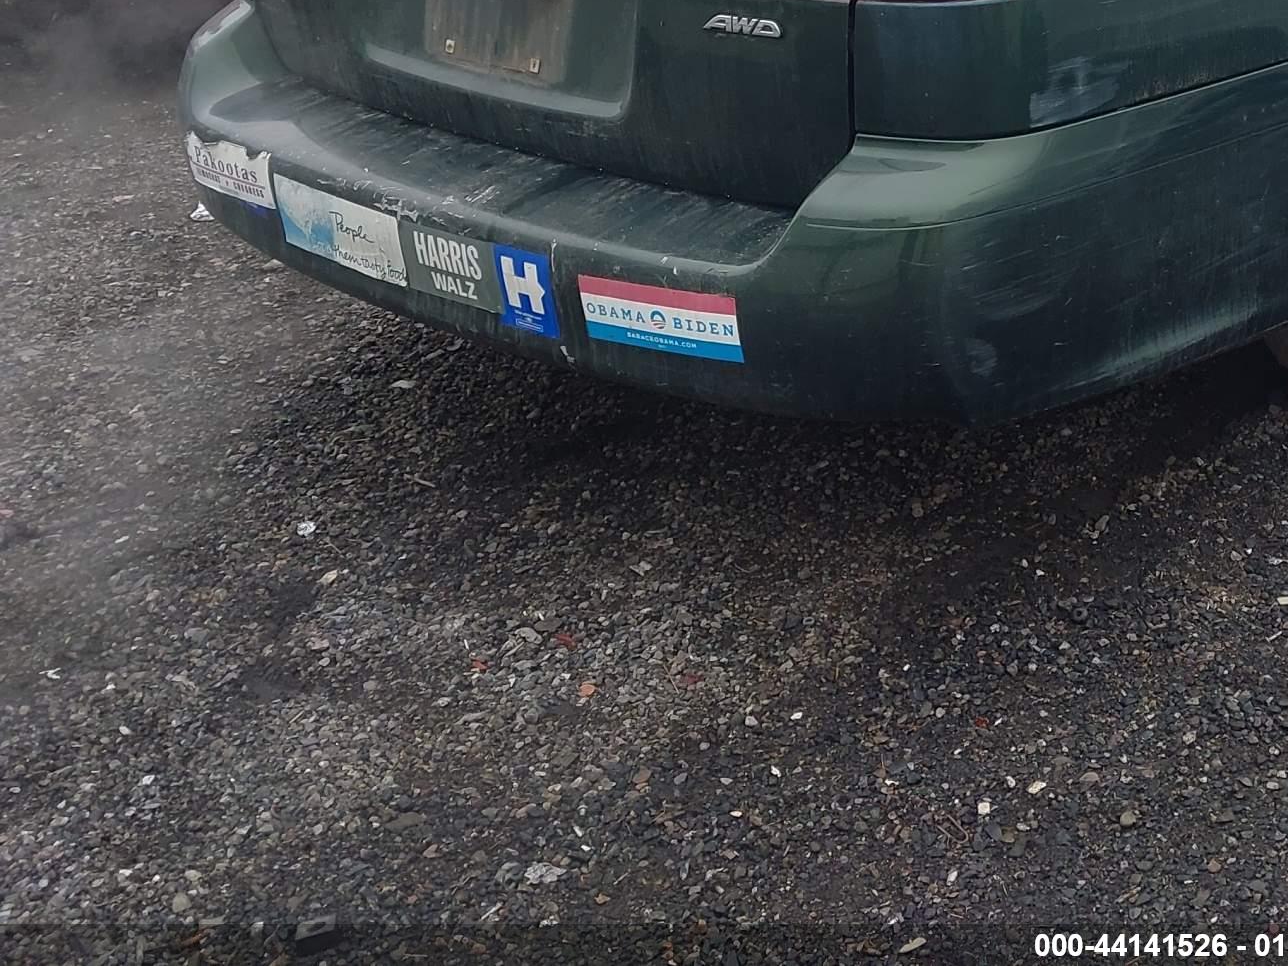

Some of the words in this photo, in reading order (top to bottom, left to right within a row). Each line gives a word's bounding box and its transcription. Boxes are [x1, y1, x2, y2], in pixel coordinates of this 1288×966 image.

[703, 14, 781, 38] AWD
[194, 145, 258, 184] Pakootas
[413, 230, 483, 281] HARRIS
[430, 271, 479, 301] WALZ
[586, 302, 646, 324] OBAMA
[672, 317, 734, 337] BIDEN
